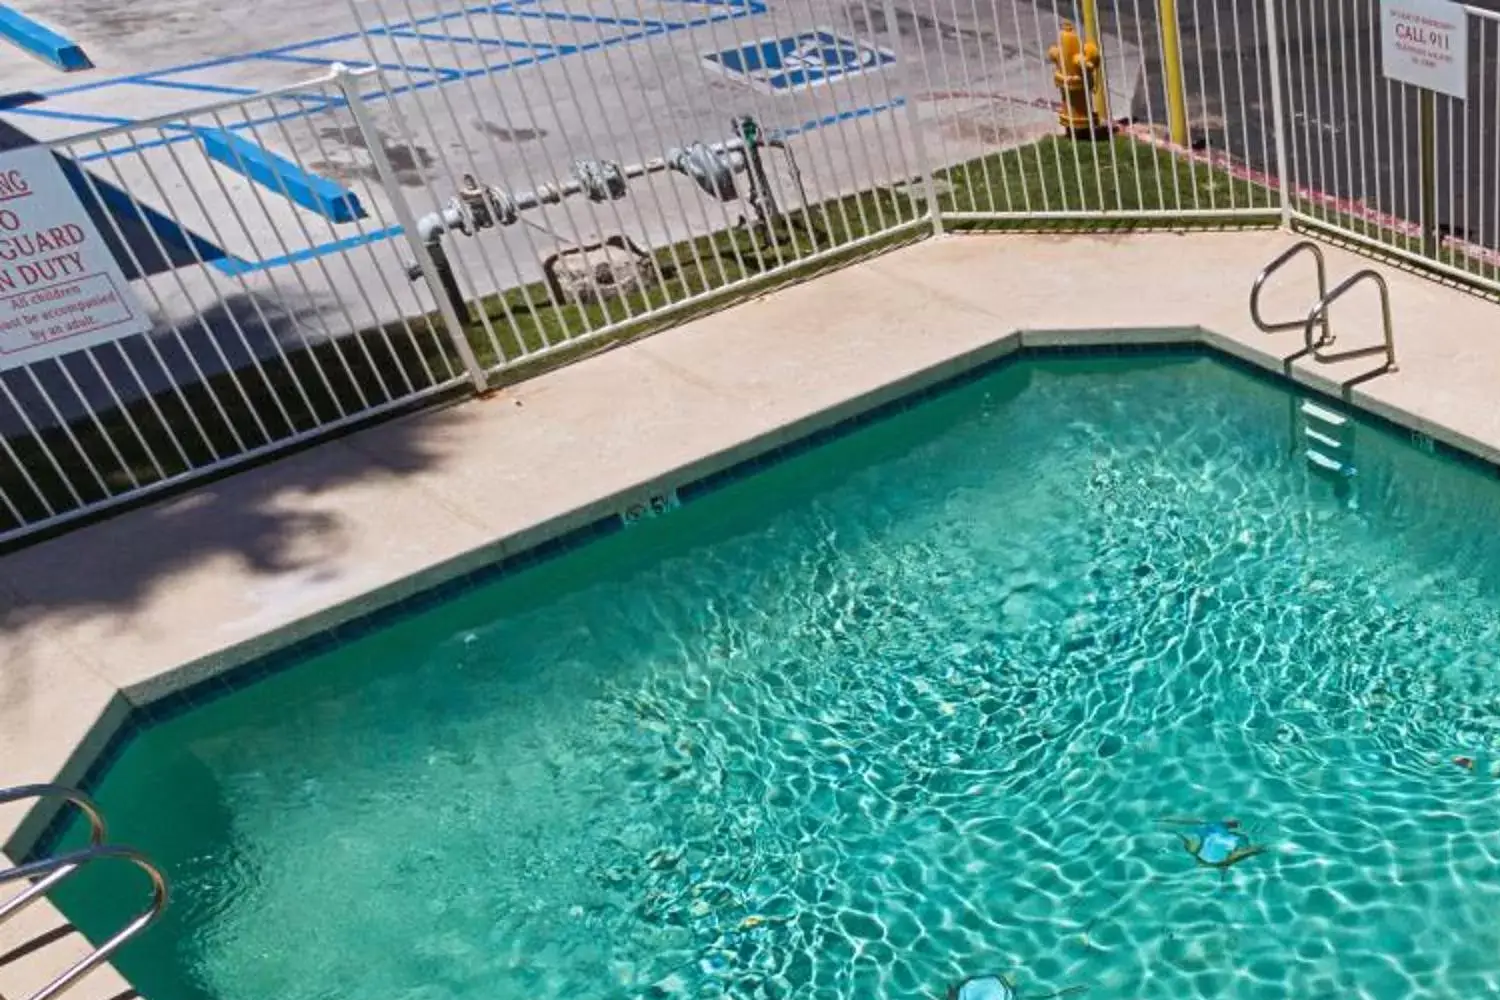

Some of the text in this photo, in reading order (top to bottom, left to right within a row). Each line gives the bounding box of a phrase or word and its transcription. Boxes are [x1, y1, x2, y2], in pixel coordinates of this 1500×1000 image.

[1395, 23, 1449, 50] CALL 911
[0, 223, 85, 261] GUARD
[16, 251, 85, 285] DUTY
